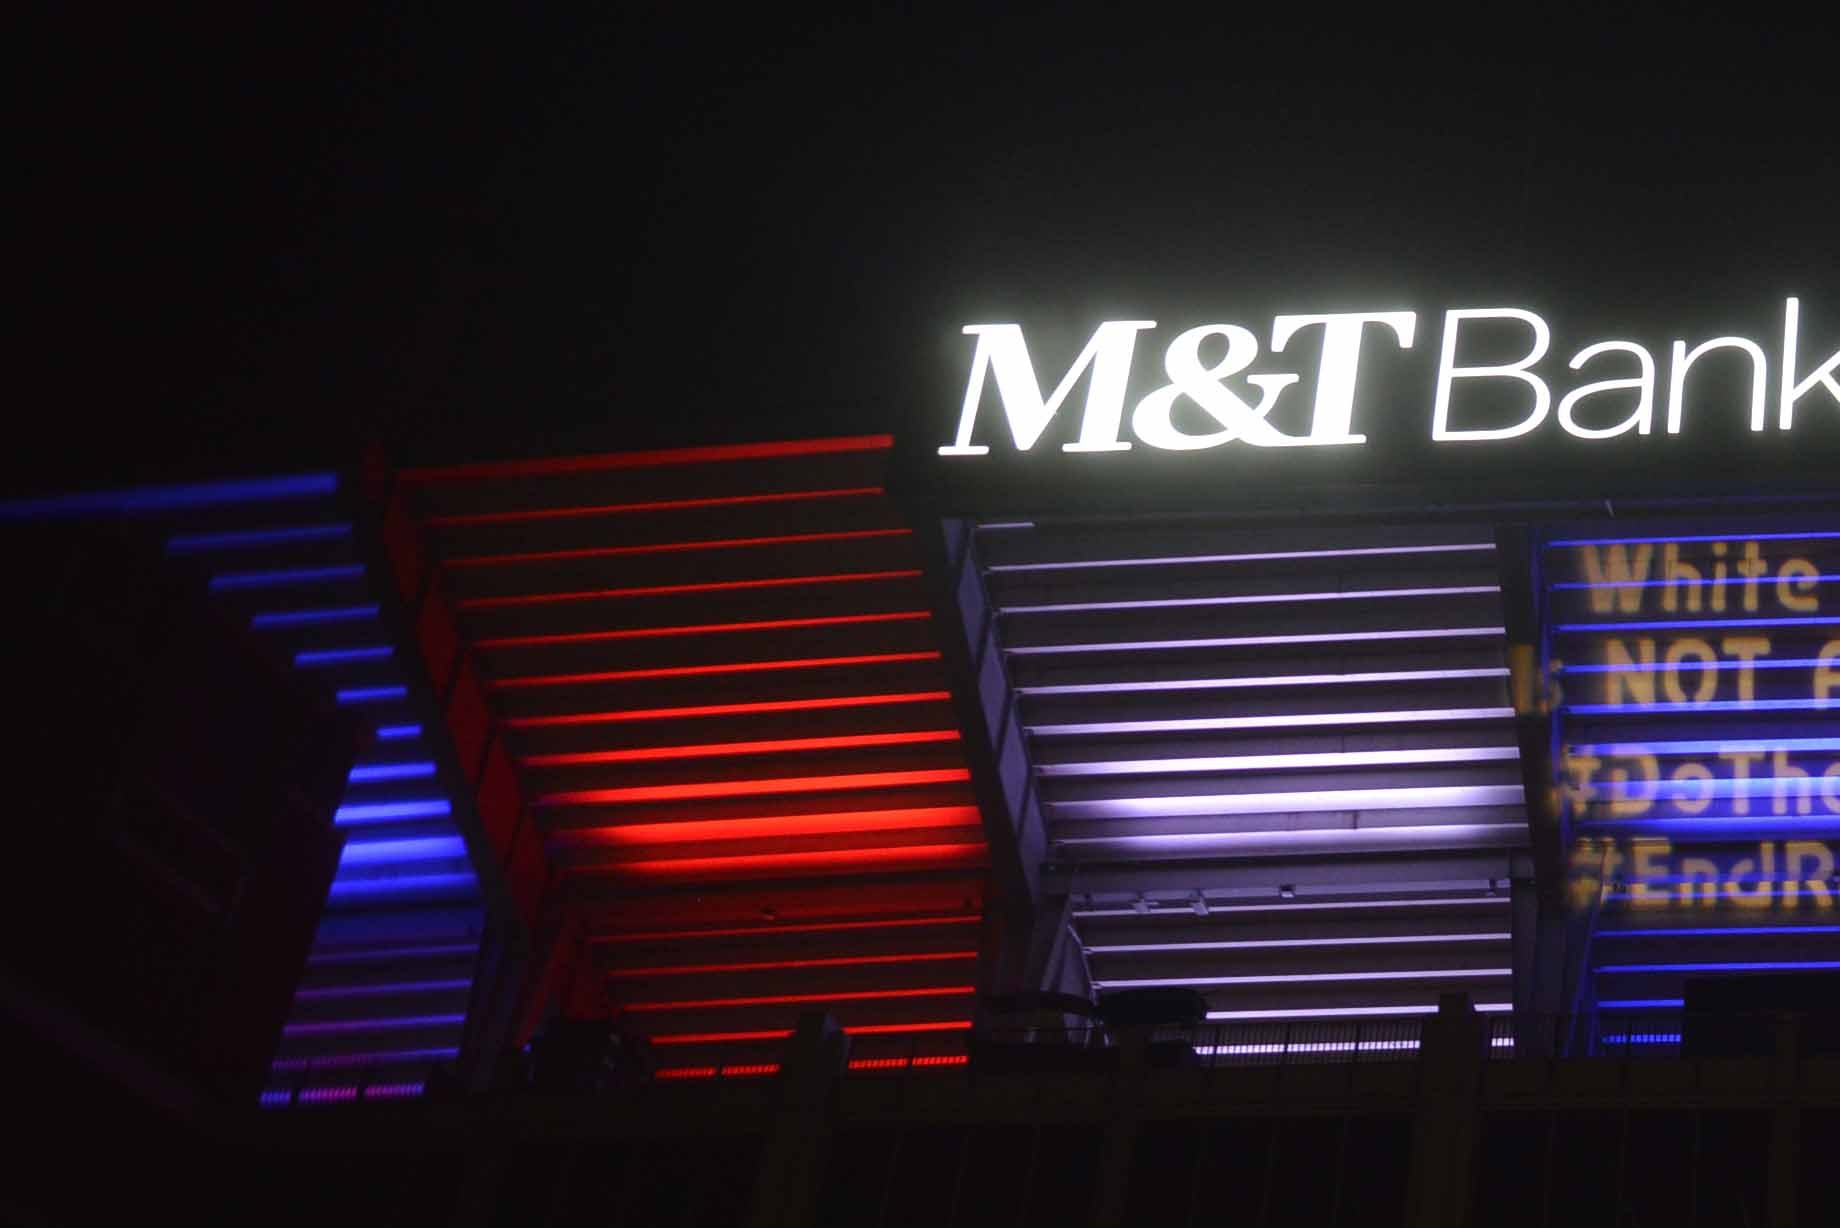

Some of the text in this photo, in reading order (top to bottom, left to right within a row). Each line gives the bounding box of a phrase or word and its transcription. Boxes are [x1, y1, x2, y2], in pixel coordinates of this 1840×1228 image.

[938, 310, 1417, 456] M&T
[1582, 542, 1820, 614] White
[1604, 636, 1771, 710] NOT
